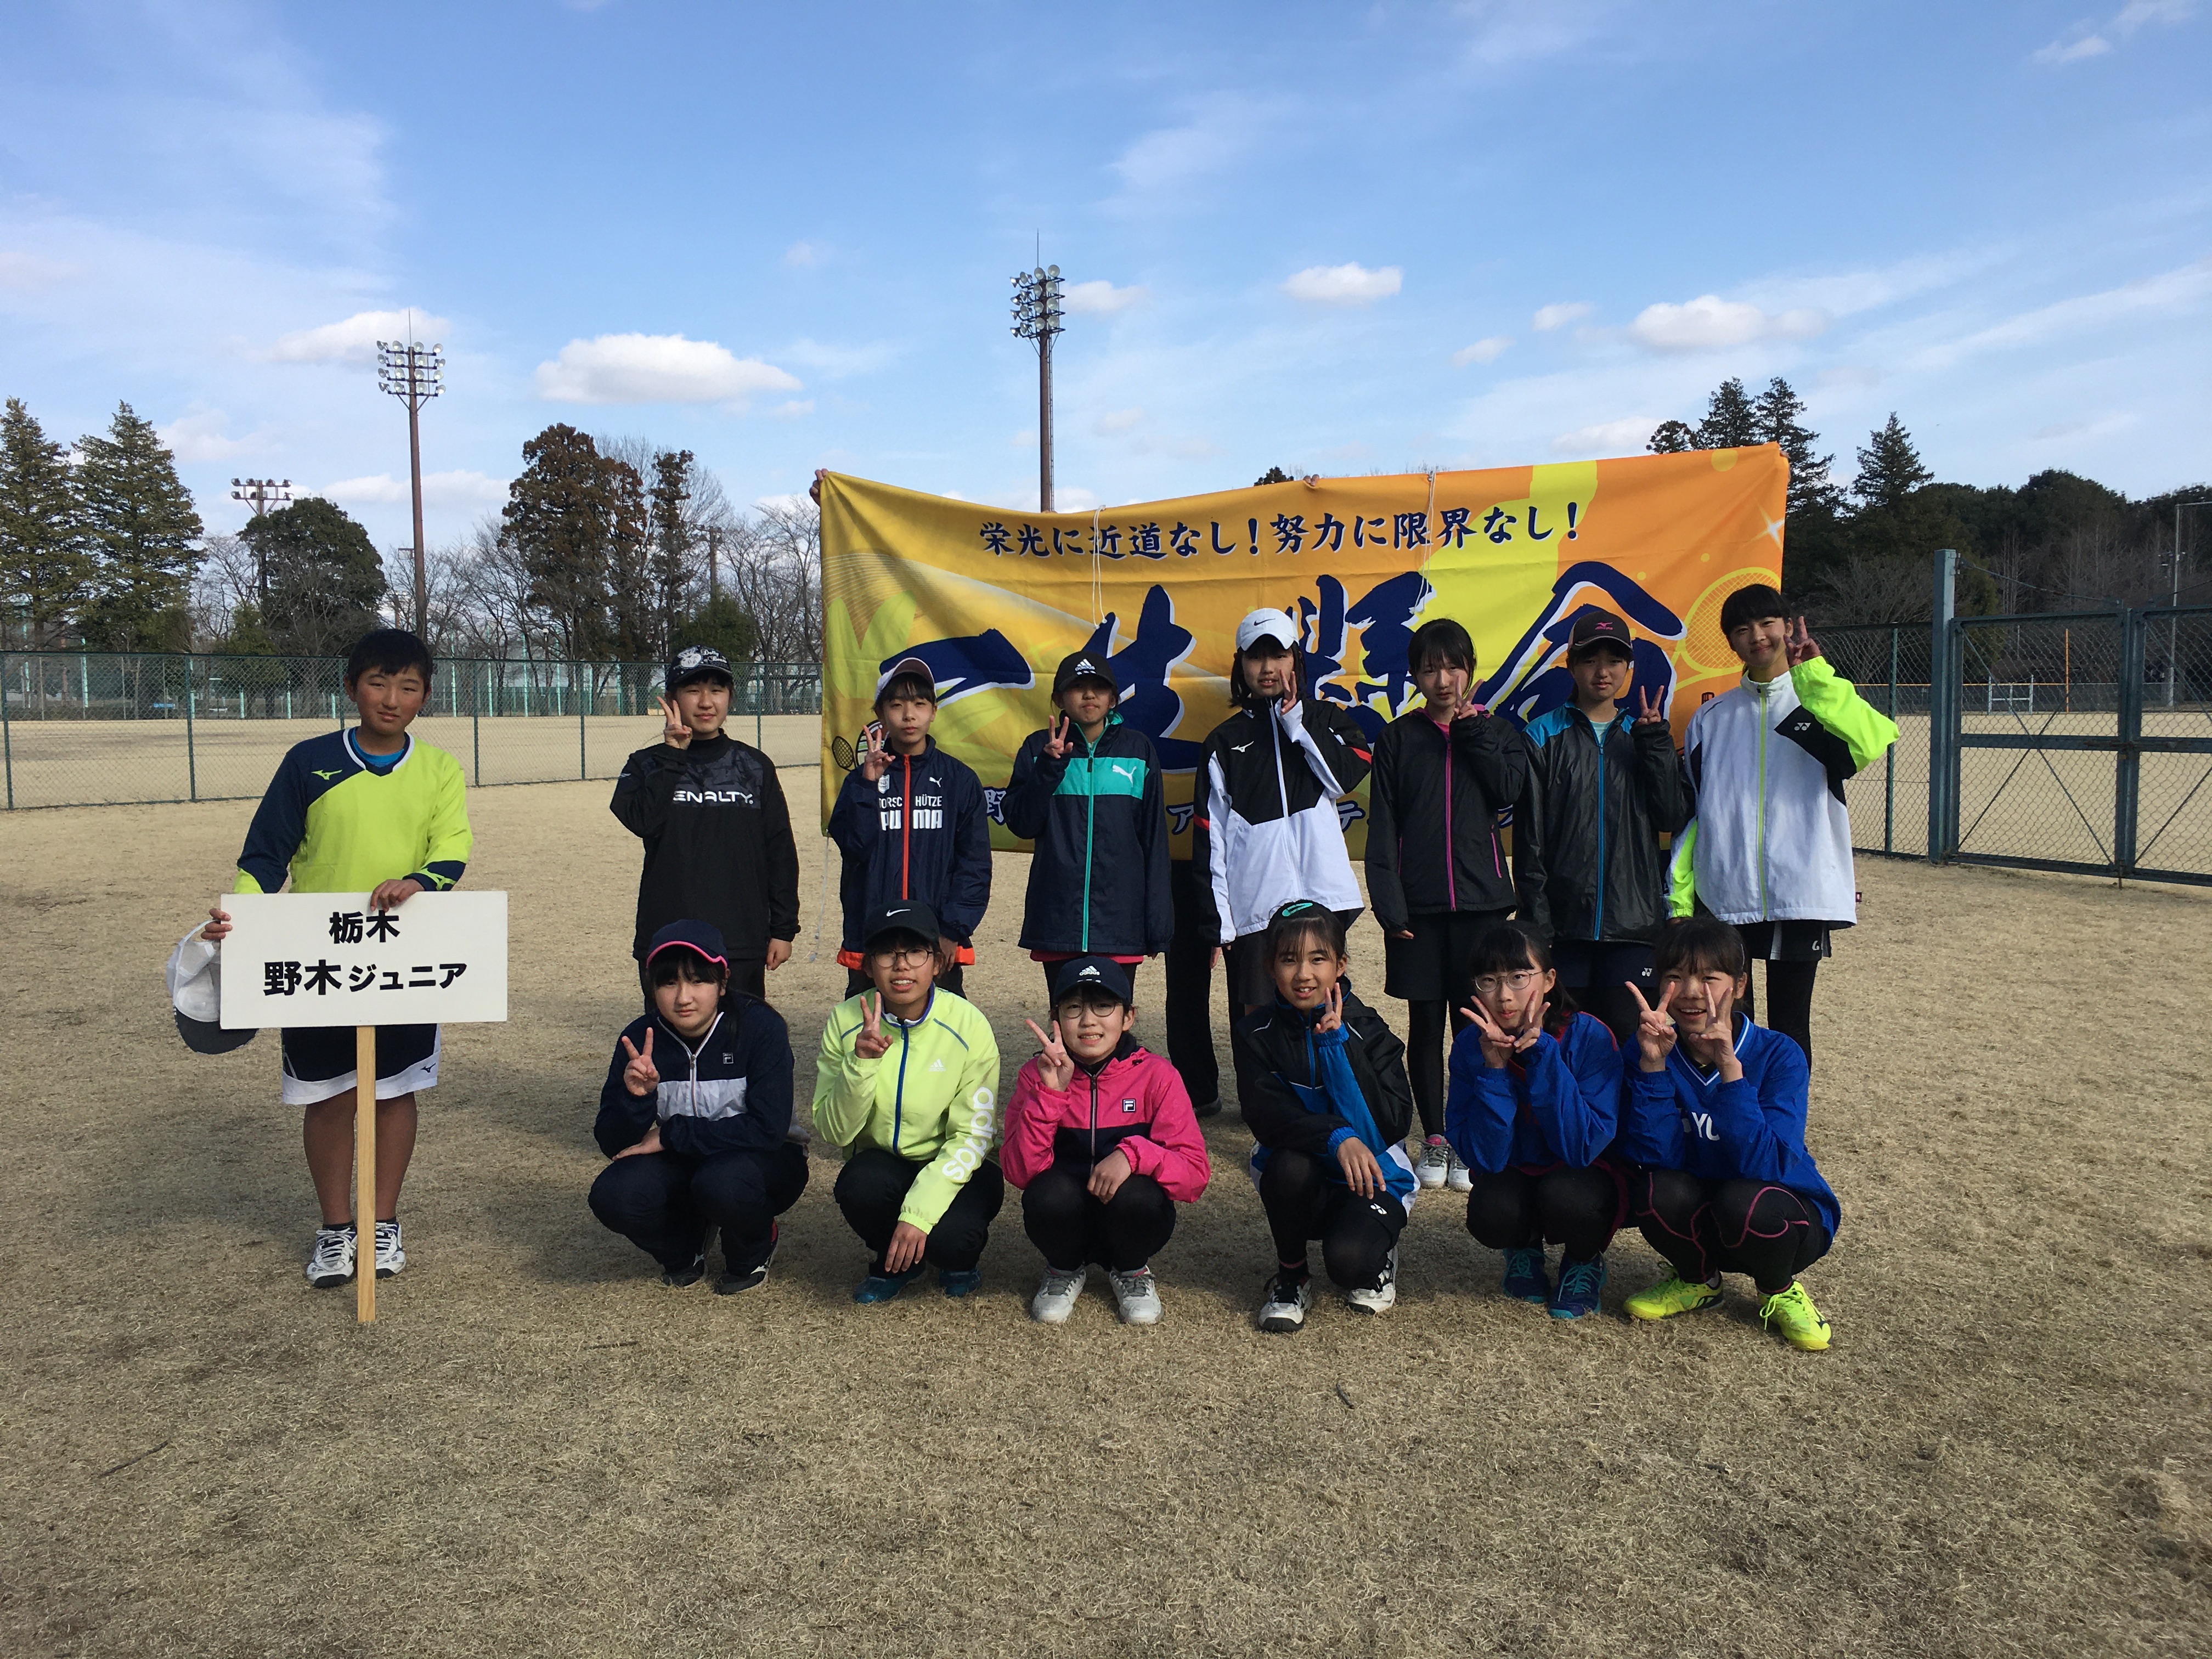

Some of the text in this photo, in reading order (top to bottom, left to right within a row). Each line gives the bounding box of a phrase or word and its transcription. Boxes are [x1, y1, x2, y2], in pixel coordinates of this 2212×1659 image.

[329, 910, 400, 944] 栃木
[263, 959, 467, 996] 野木ジュニア
[941, 1086, 997, 1180] adidas
